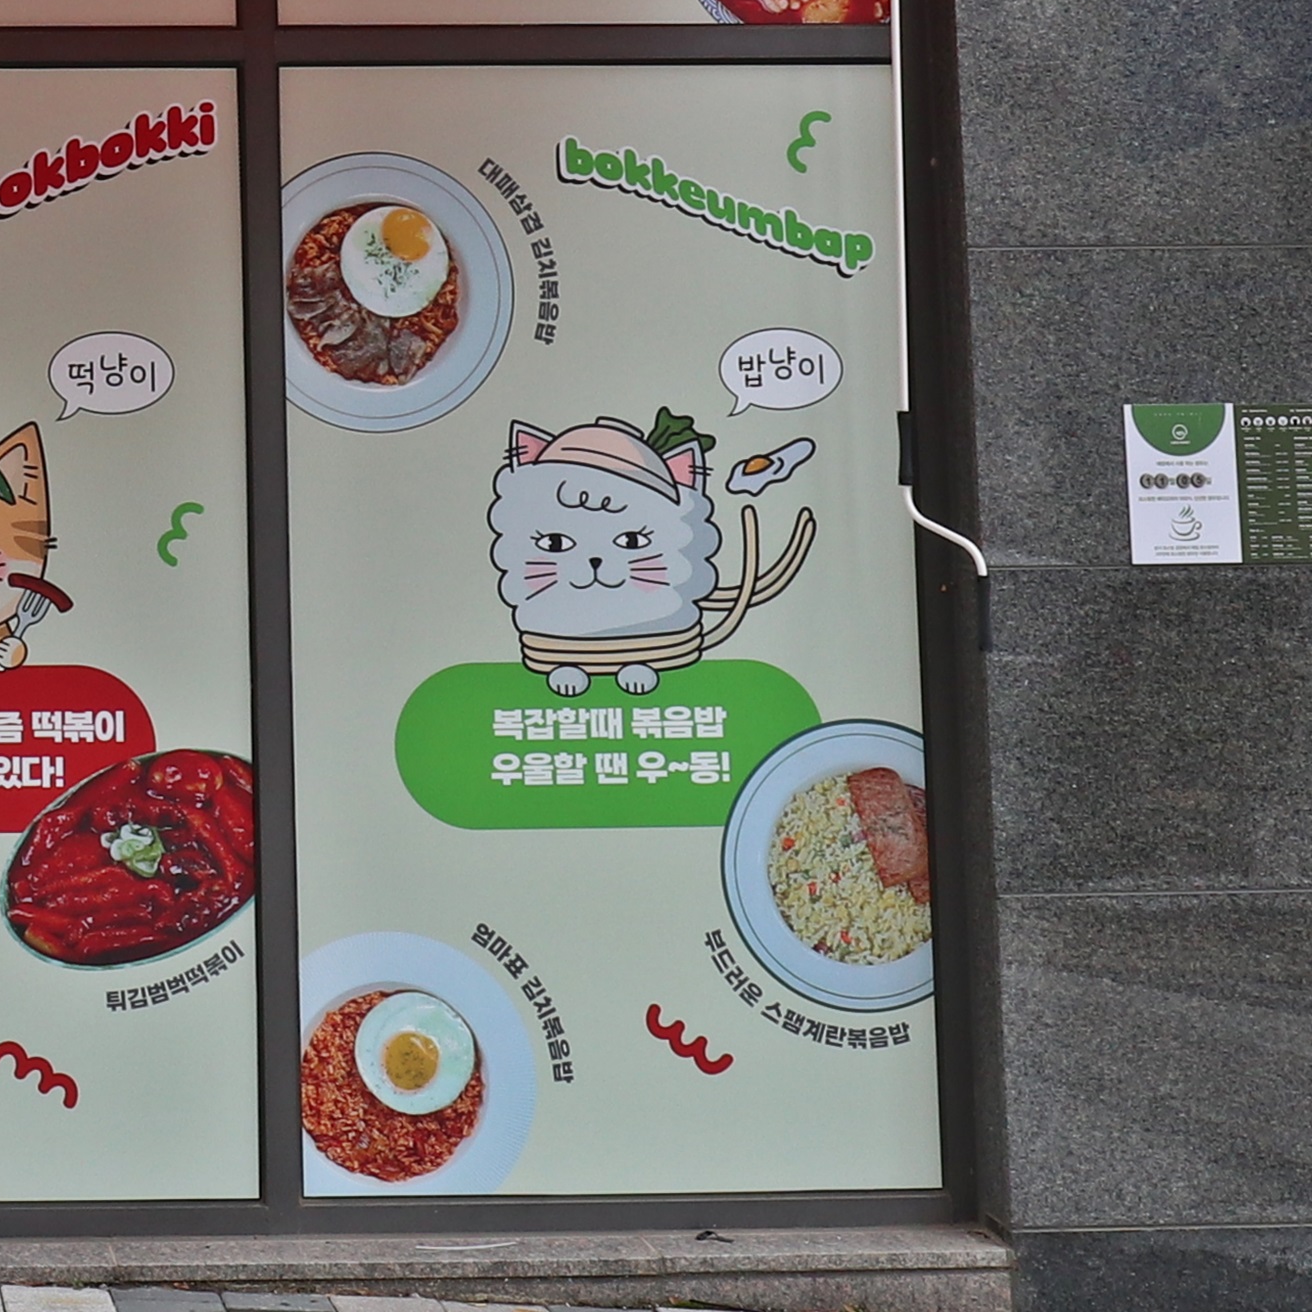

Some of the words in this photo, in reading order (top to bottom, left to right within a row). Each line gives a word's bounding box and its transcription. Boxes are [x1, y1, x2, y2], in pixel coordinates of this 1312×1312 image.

[556, 136, 875, 278] bokkeumbap
[530, 237, 560, 346] 김치볶음밥
[67, 352, 156, 394] 떡냥이
[738, 346, 825, 388] 밥냥이
[31, 711, 125, 744] 떡볶이
[630, 706, 727, 739] 볶음밥
[490, 752, 588, 786] 우울할
[594, 752, 629, 785] 땐
[634, 750, 731, 784] 우~동!
[105, 939, 246, 1013] 튀김범벅떡볶이
[470, 922, 530, 980] 엄마표
[520, 975, 575, 1085] 김치볶음밥
[703, 928, 765, 1008] 부드러운
[761, 1001, 912, 1051] 스팸계란볶음밥
